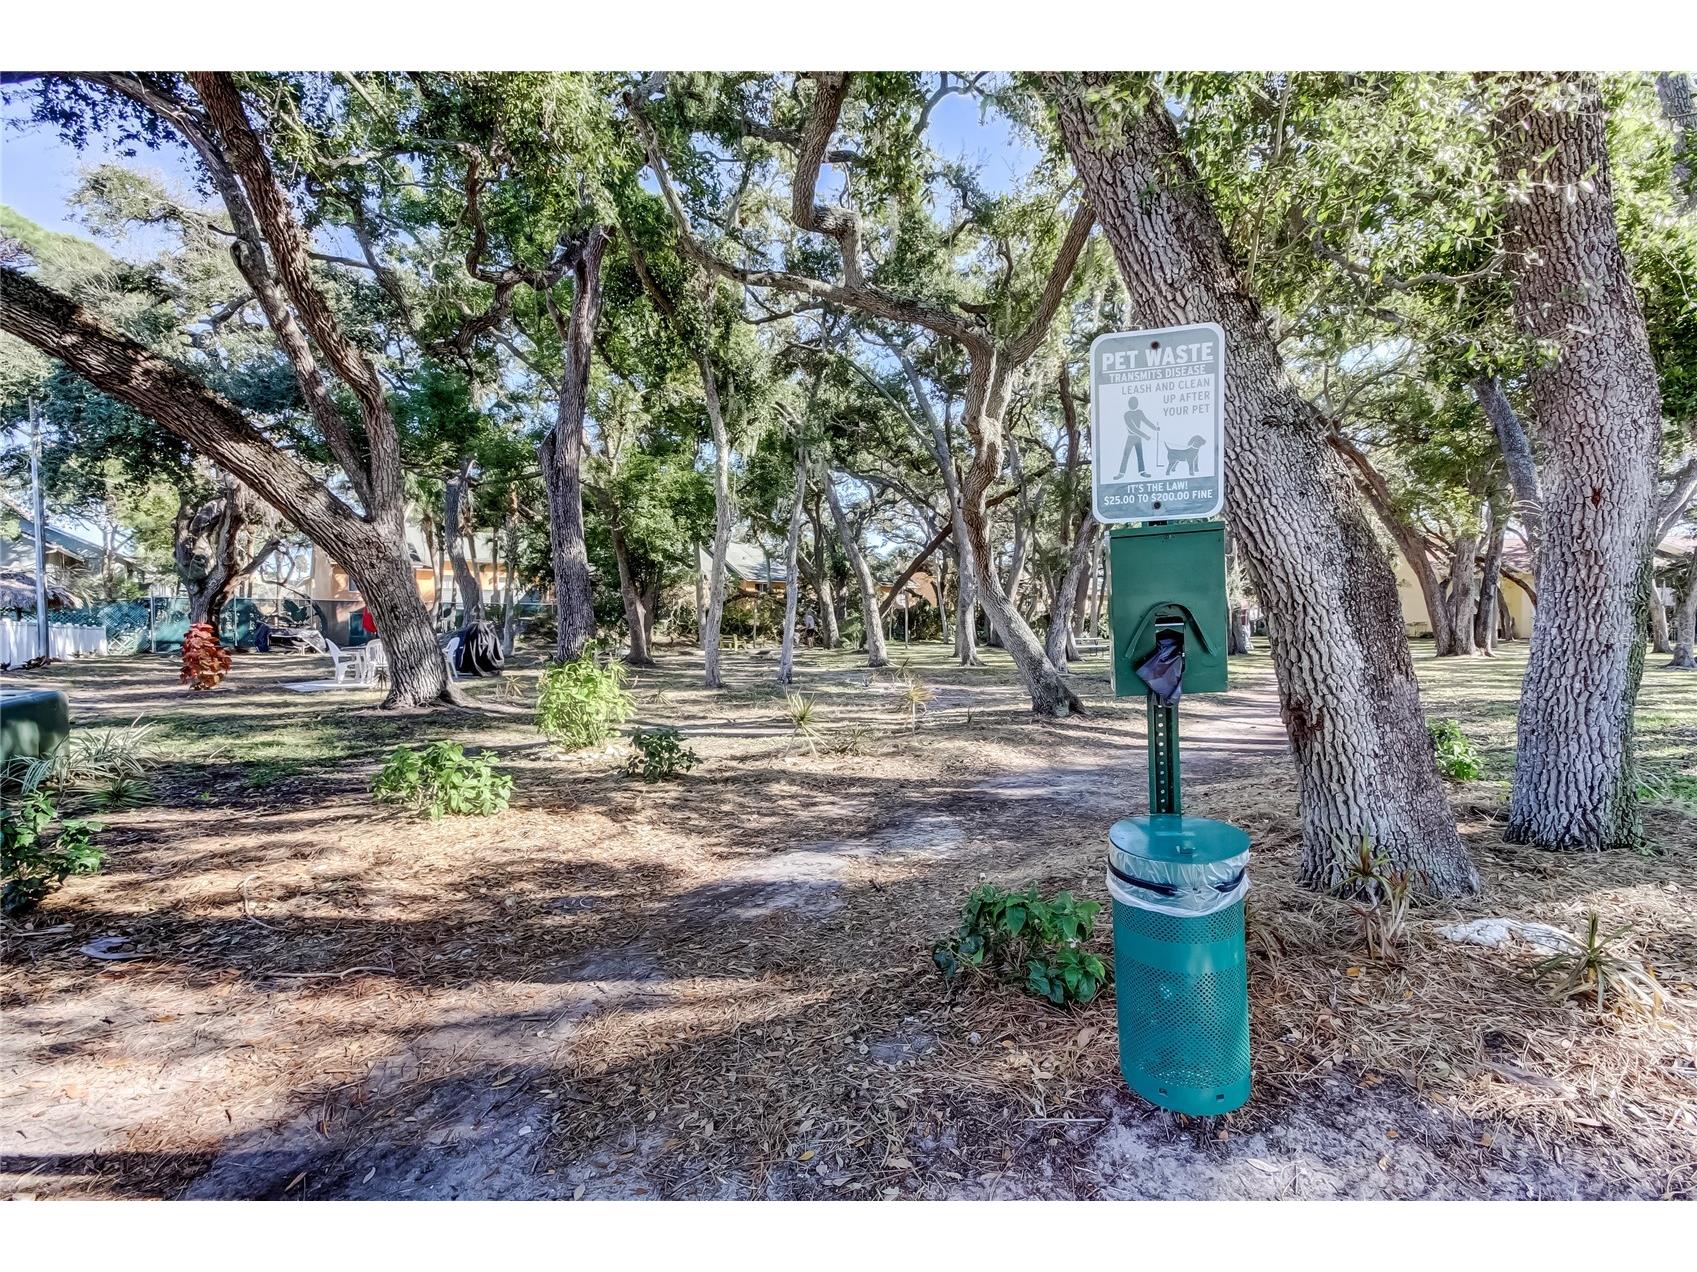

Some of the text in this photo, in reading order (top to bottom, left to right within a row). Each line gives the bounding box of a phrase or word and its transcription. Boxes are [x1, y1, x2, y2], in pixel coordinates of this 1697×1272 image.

[1102, 342, 1214, 370] PET WASTE
[1109, 365, 1205, 383] TRANSMITS DISEASE
[1121, 378, 1210, 395] LEASH AND CLEAN
[1163, 391, 1210, 403] UP AFTER
[1163, 403, 1210, 416] YOUR PET
[1127, 481, 1188, 493] IT'S THE LAW!
[1104, 489, 1213, 506] $25.00 TO $200.00 FINE
